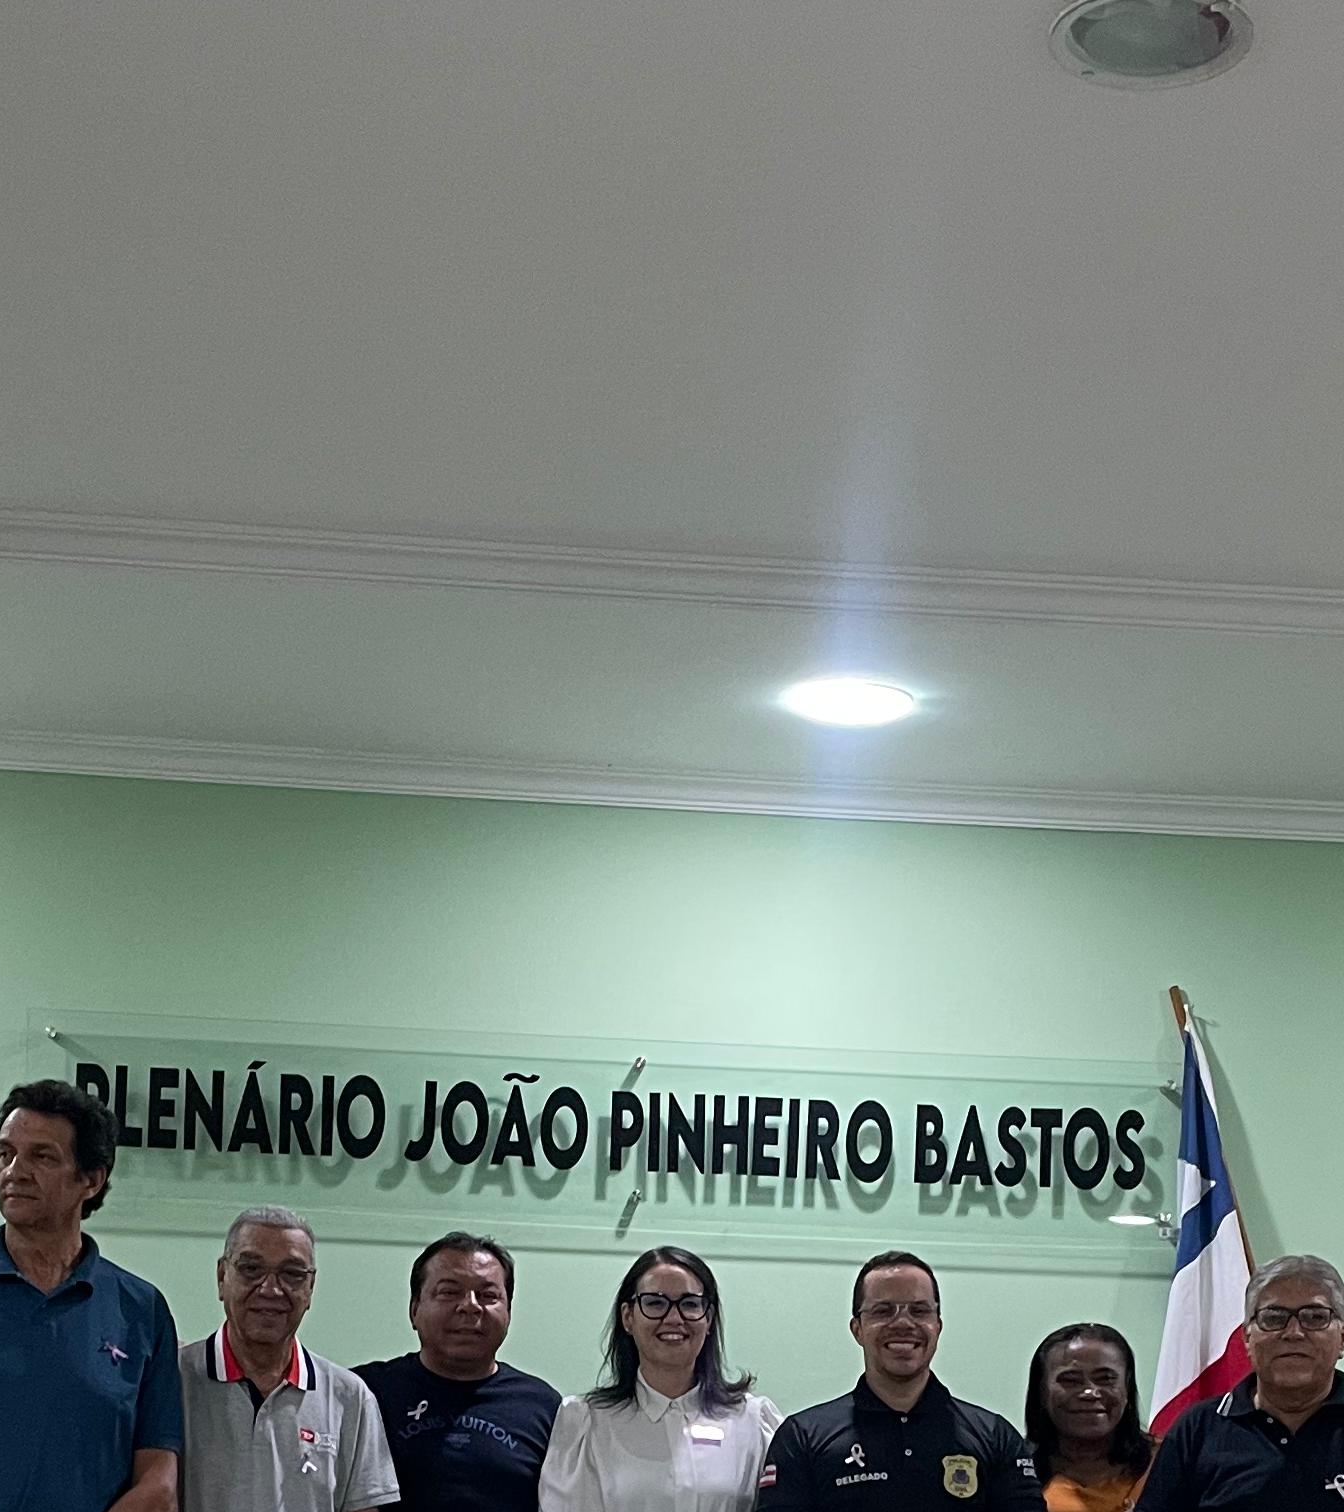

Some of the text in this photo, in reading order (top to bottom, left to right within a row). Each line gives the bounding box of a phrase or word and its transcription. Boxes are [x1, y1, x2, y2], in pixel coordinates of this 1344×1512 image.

[76, 1060, 1146, 1191] PLENÁRIO JOÃO PINHEIRO BASTOS
[452, 1414, 518, 1450] VUITTON
[835, 1472, 888, 1486] DELEGADO
